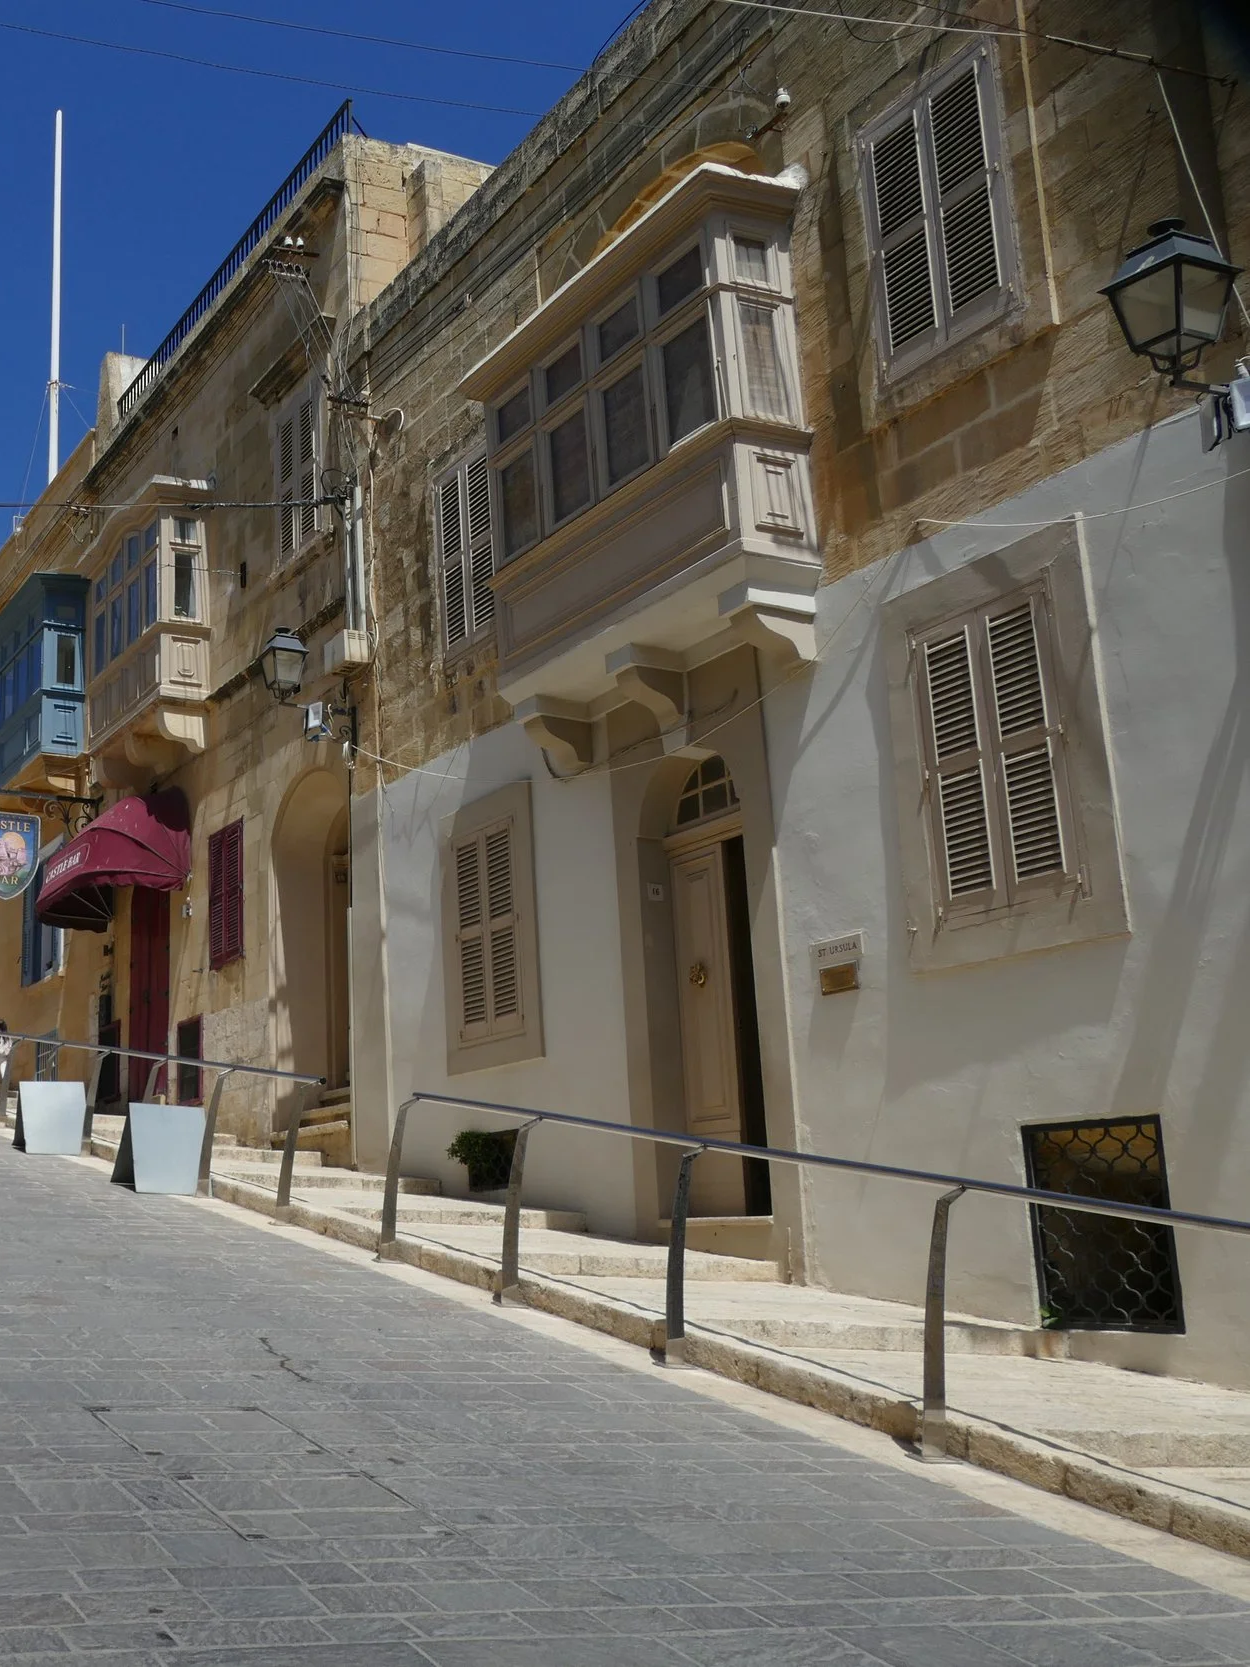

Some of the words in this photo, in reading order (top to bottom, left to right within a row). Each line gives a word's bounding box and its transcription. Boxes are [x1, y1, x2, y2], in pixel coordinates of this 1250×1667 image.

[45, 859, 69, 884] CASTLE
[67, 851, 81, 869] BAR
[817, 948, 827, 958] ST
[829, 941, 858, 955] URSULA
